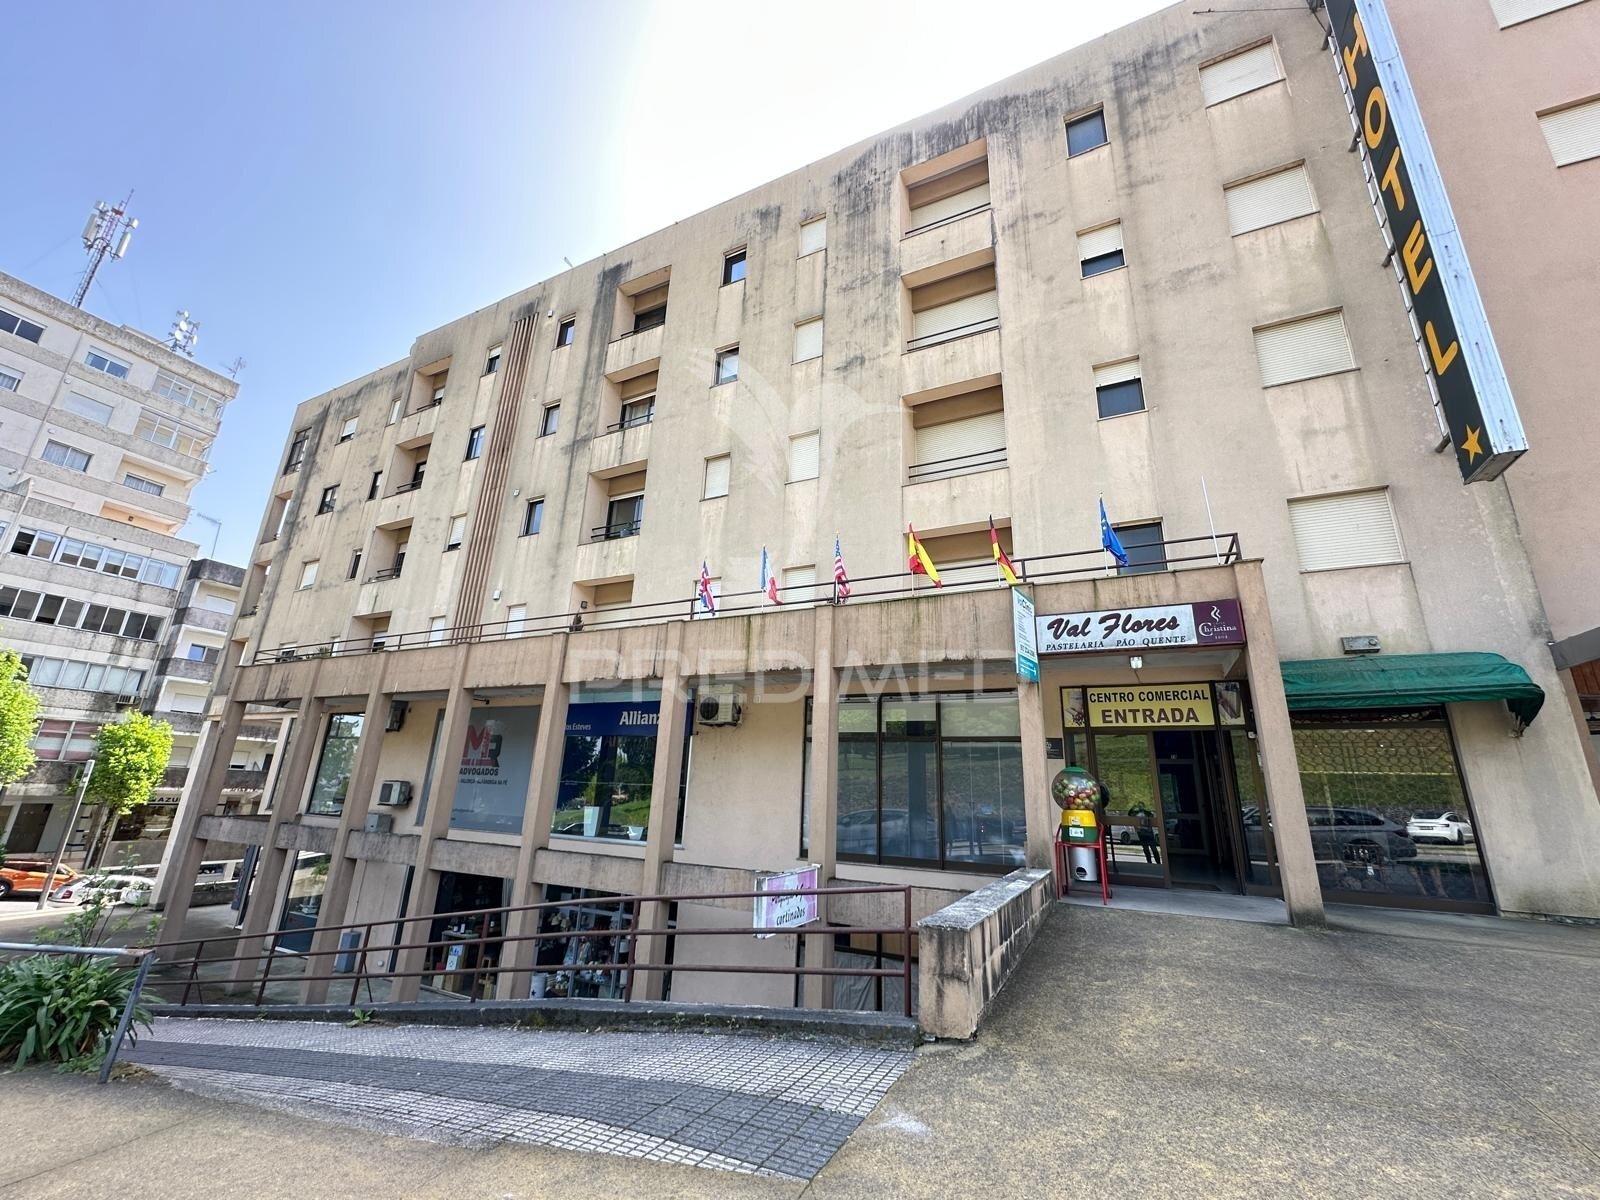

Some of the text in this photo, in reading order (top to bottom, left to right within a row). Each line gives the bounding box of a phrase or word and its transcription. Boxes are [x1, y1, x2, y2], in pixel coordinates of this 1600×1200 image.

[1343, 13, 1459, 376] HOTEL
[1047, 617, 1091, 640] Val
[1099, 613, 1180, 639] Flores
[1198, 622, 1237, 637] Christina
[1046, 641, 1104, 651] PASTELARIA
[1142, 635, 1186, 647] QUENTE
[1089, 689, 1209, 703] CENTRO COMERCIAL
[1101, 707, 1200, 724] ENTRADA
[459, 767, 499, 776] ADVOGADOS
